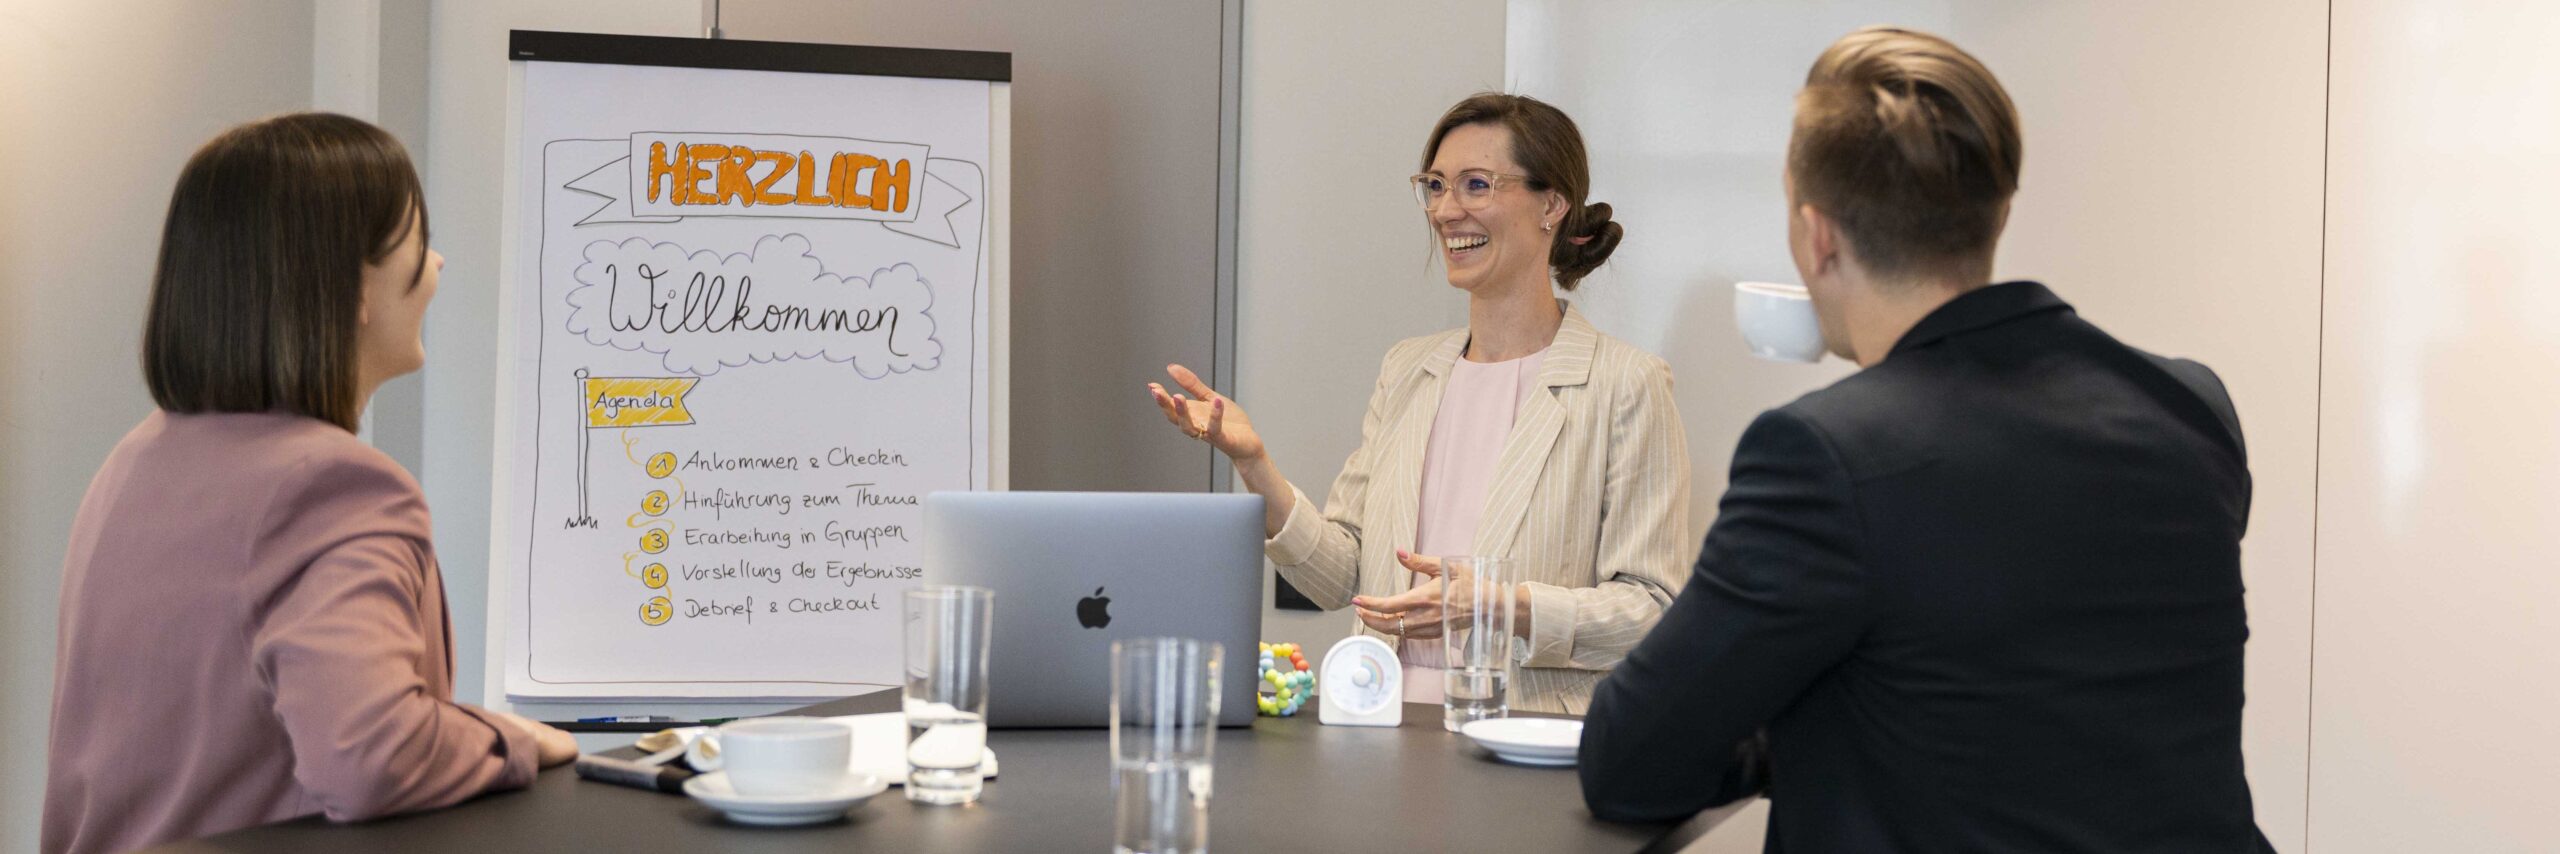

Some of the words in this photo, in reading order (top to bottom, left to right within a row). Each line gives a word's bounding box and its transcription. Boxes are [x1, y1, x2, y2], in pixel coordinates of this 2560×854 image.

[648, 141, 911, 213] HERZLICH
[605, 262, 909, 357] Willkommen
[593, 387, 674, 418] Agenda
[655, 459, 669, 471] 1
[681, 451, 798, 471] Ankommen
[827, 447, 909, 467] Checkin
[652, 497, 662, 508] 2
[684, 491, 791, 520] Hinführung
[802, 493, 841, 507] zum
[845, 483, 919, 506] Thema
[651, 534, 664, 550] 3
[684, 530, 792, 549] Erarbeitung
[801, 528, 816, 544] in
[824, 522, 909, 551] Gruppen
[650, 569, 660, 581] 4
[682, 562, 782, 584] Vorstellung
[826, 562, 923, 587] Ergebnisse
[648, 605, 662, 620] 5
[684, 597, 754, 624] Debrief
[788, 593, 880, 614] Checkout
